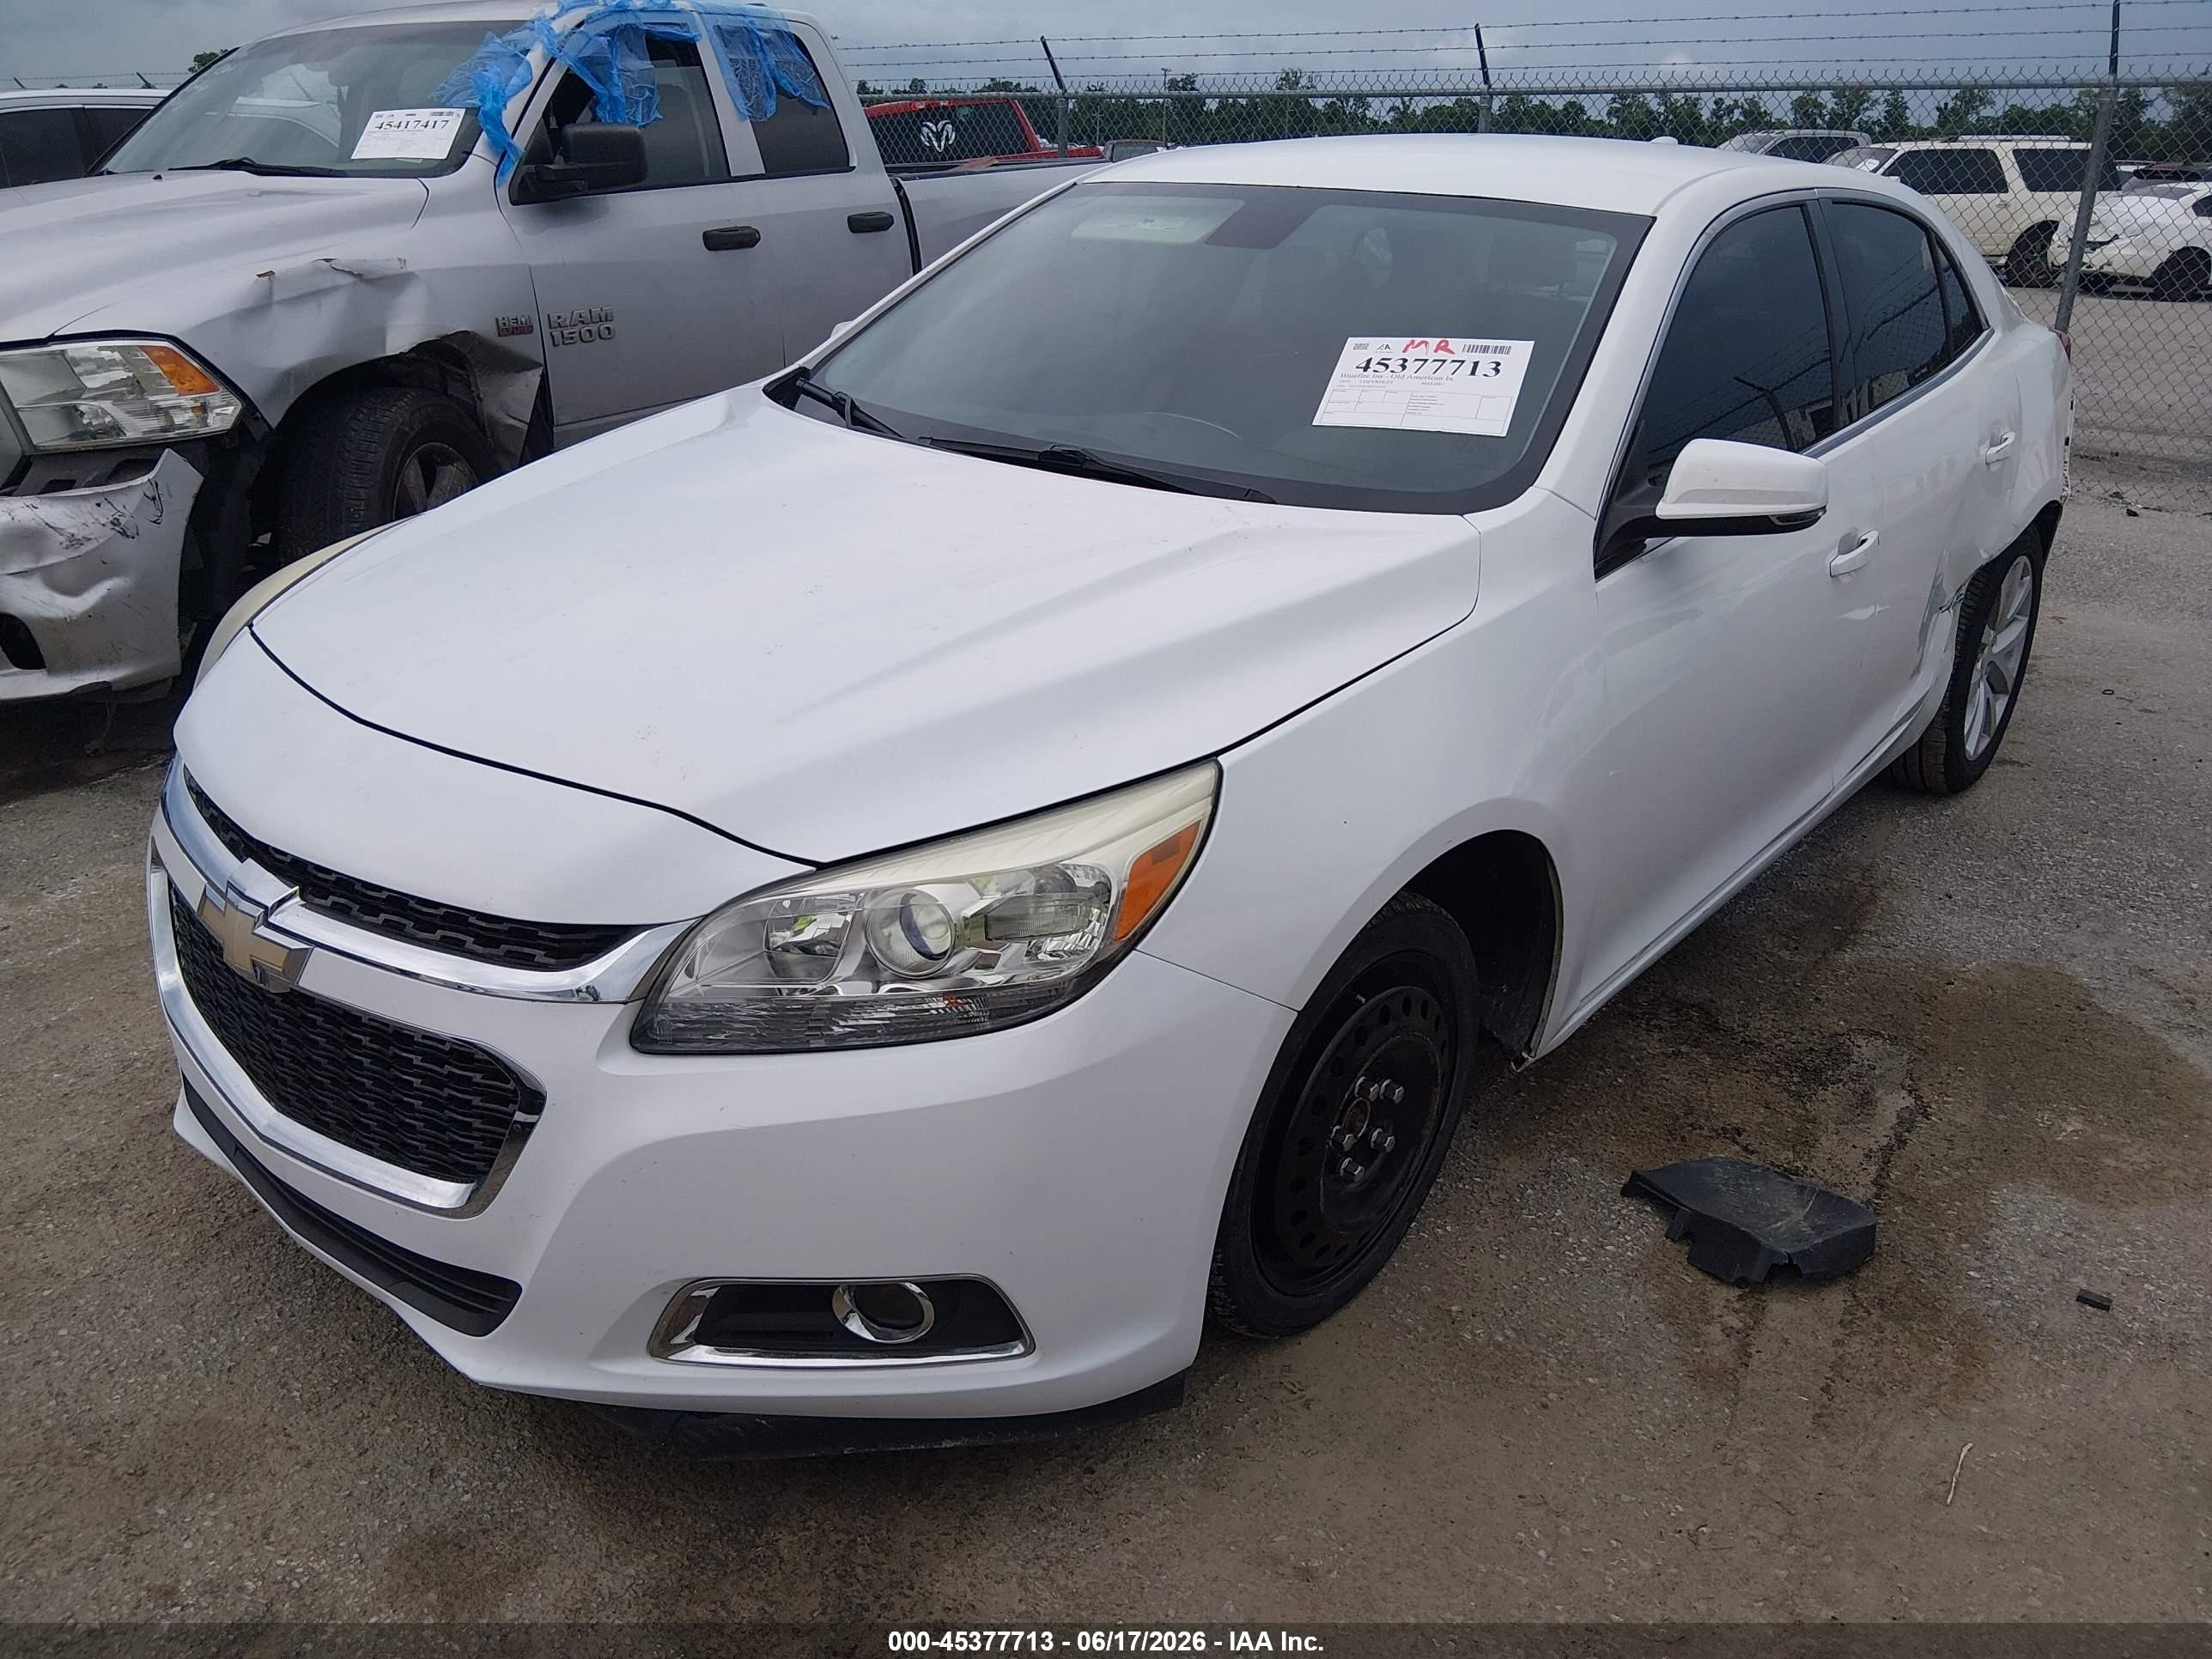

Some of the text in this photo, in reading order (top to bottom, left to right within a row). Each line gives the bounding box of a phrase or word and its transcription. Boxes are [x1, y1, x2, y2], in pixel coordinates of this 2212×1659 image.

[375, 119, 450, 131] 45417417
[548, 306, 614, 329] RAM
[550, 324, 616, 347] 1500
[1355, 356, 1502, 378] 45377713
